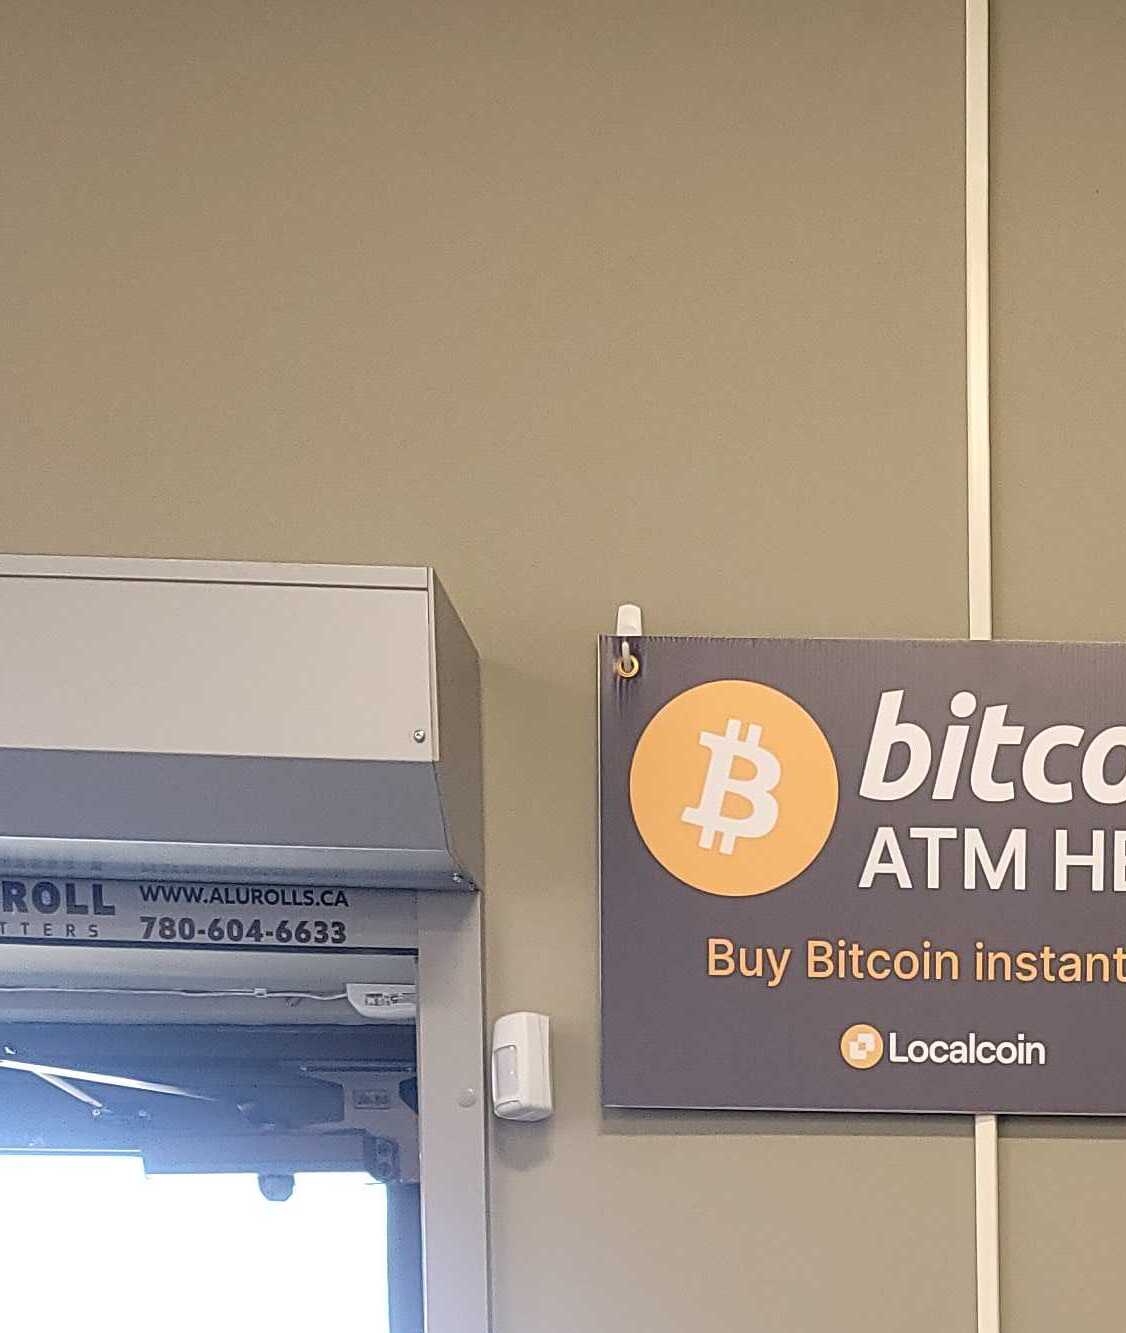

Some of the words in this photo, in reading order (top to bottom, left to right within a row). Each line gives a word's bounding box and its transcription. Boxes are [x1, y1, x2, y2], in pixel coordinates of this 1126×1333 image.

[857, 826, 1028, 890] ATM
[2, 880, 115, 916] ROLL
[139, 885, 349, 908] WWW.ALUROLLS.CA
[139, 916, 347, 944] 780-604-6633
[707, 937, 791, 988] Buy
[806, 940, 959, 981] Bitcoin
[889, 1032, 1046, 1066] Localcoin
